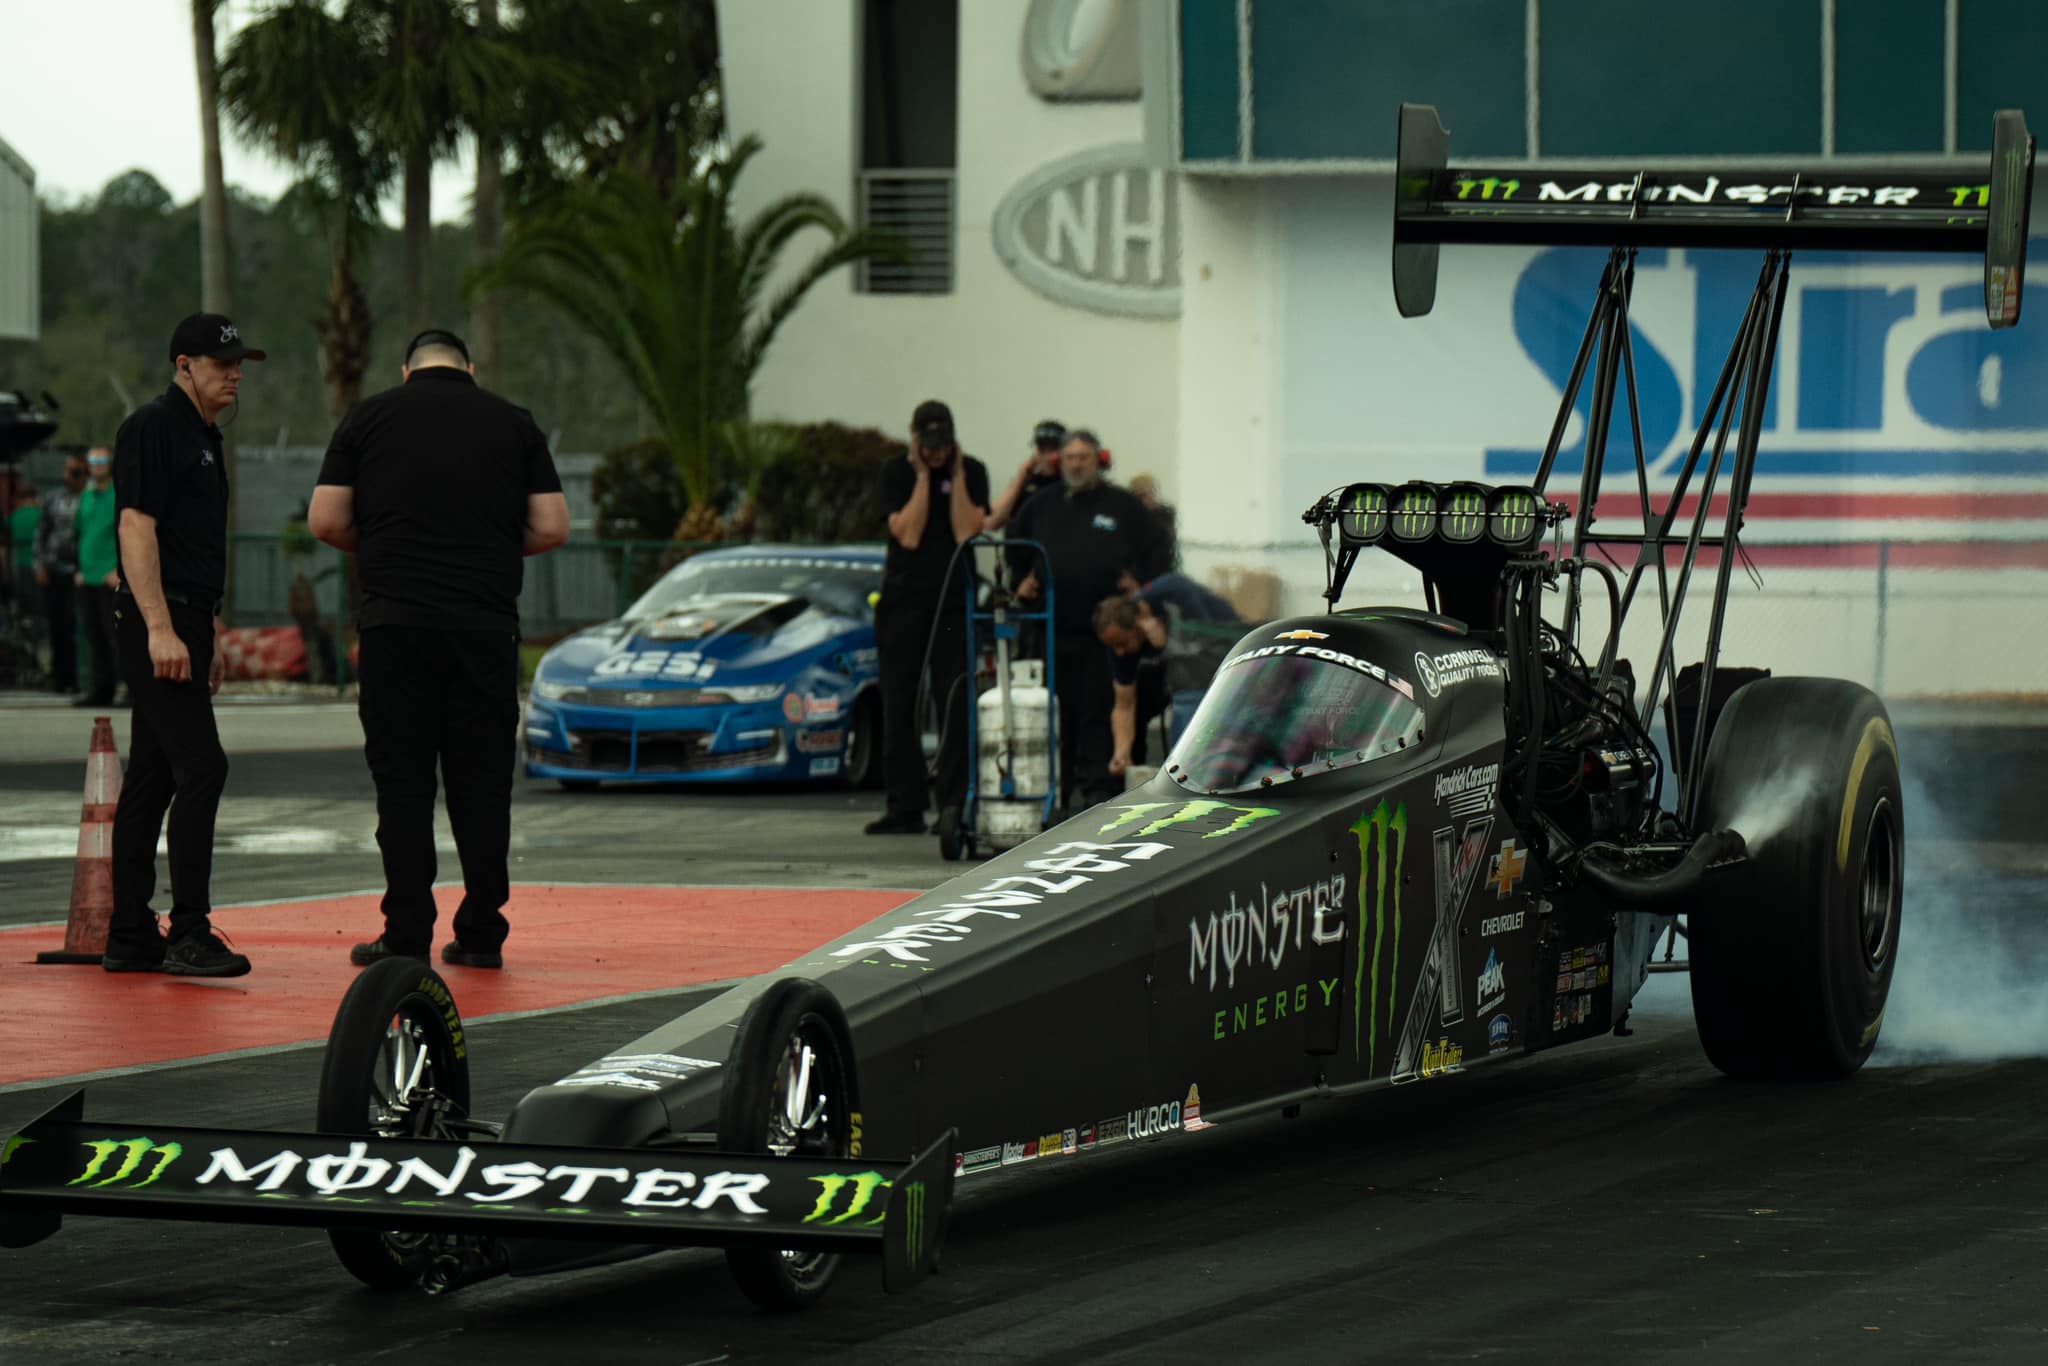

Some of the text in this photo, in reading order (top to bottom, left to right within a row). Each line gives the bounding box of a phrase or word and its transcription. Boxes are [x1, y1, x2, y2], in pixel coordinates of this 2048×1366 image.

[1296, 646, 1387, 681] FORCE
[1434, 648, 1495, 672] CORNWELL
[1440, 664, 1475, 687] QUALITY
[1189, 873, 1347, 993] MONSTER
[1481, 911, 1525, 937] CHEVROLET
[1476, 961, 1505, 1006] PEAK
[1213, 978, 1342, 1041] ENERGY
[850, 1111, 864, 1160] EAG
[1127, 1101, 1181, 1141] HURCO
[195, 1141, 770, 1216] MONSTER
